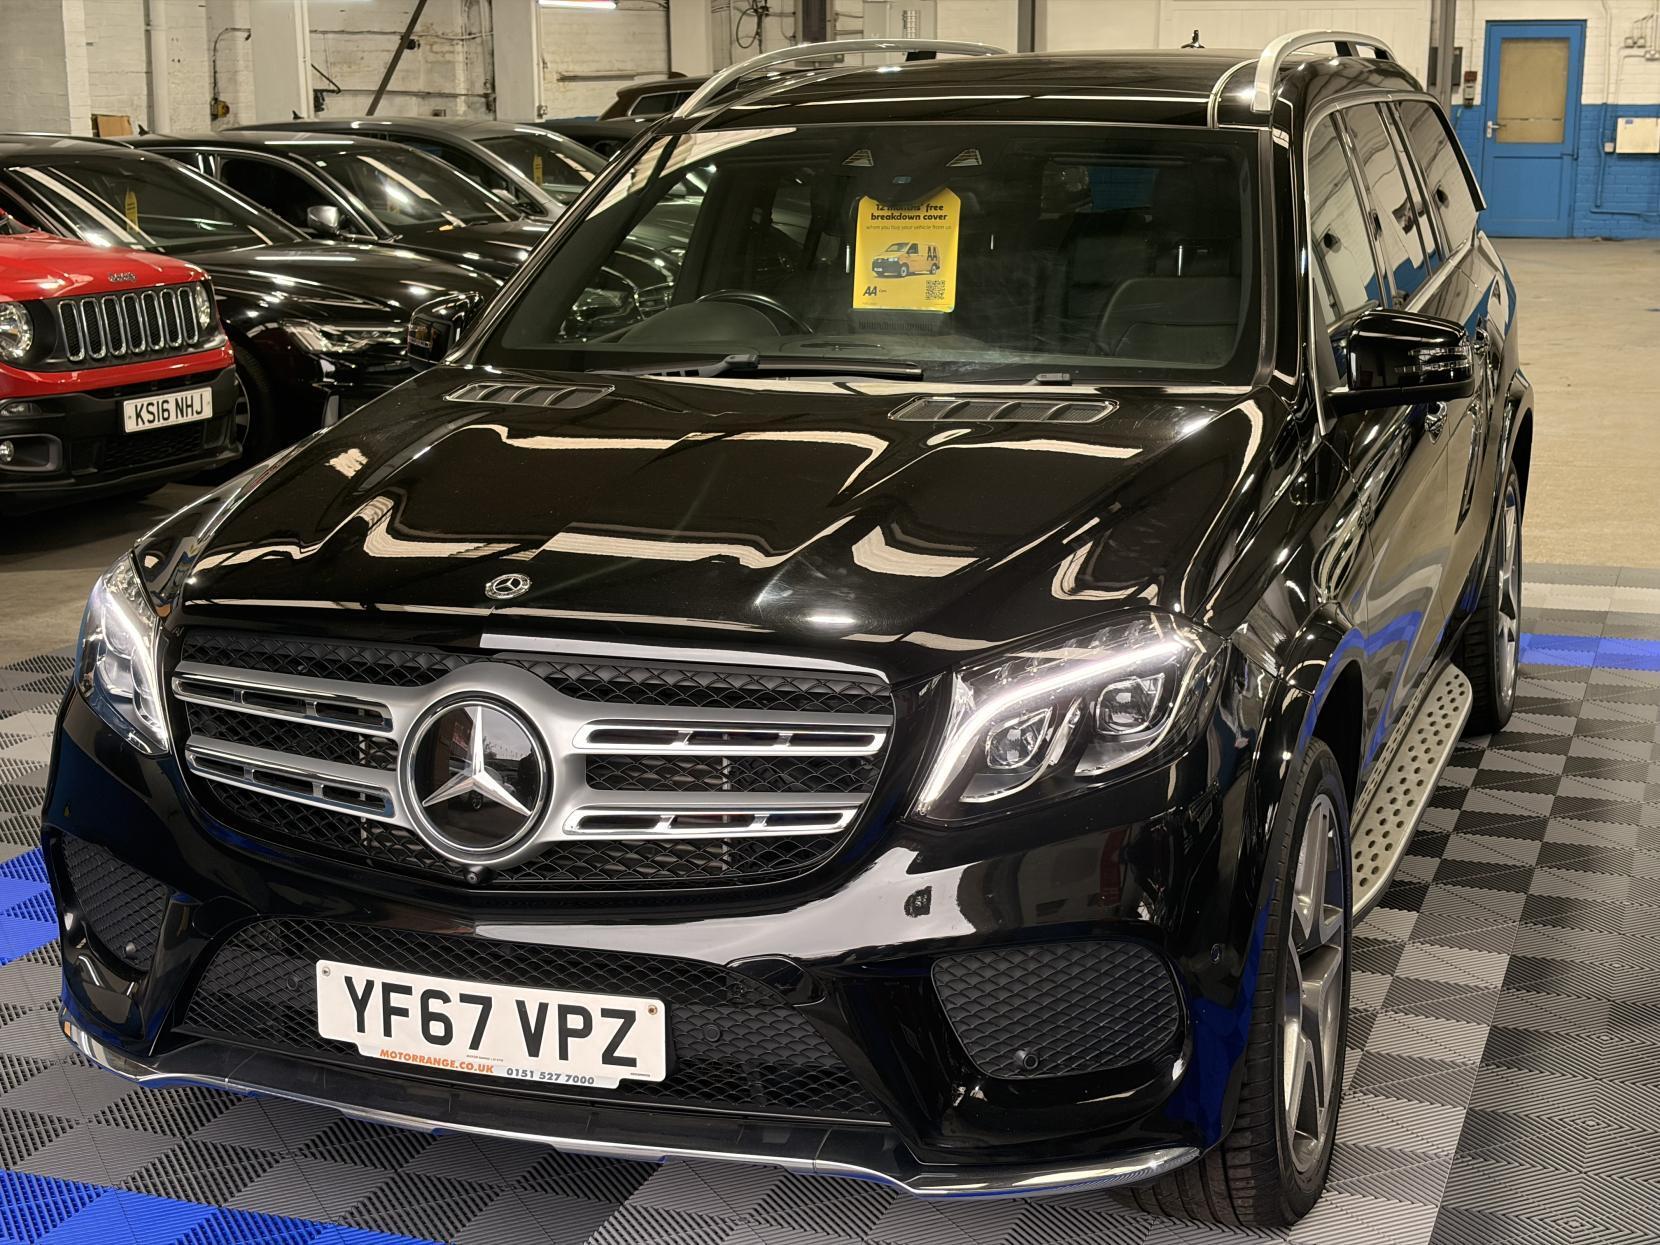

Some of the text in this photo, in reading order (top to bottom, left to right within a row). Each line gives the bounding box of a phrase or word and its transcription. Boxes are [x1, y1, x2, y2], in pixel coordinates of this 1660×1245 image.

[926, 203, 944, 212] free
[871, 212, 920, 221] breakdown
[927, 247, 937, 261] AA
[863, 285, 877, 296] AA
[134, 393, 203, 427] KS16 NHJ
[344, 975, 637, 1068] YF67 VPZ
[379, 1048, 495, 1074] MOTORRANGE.CO.UK
[506, 1067, 595, 1085] 0151 527 7000
